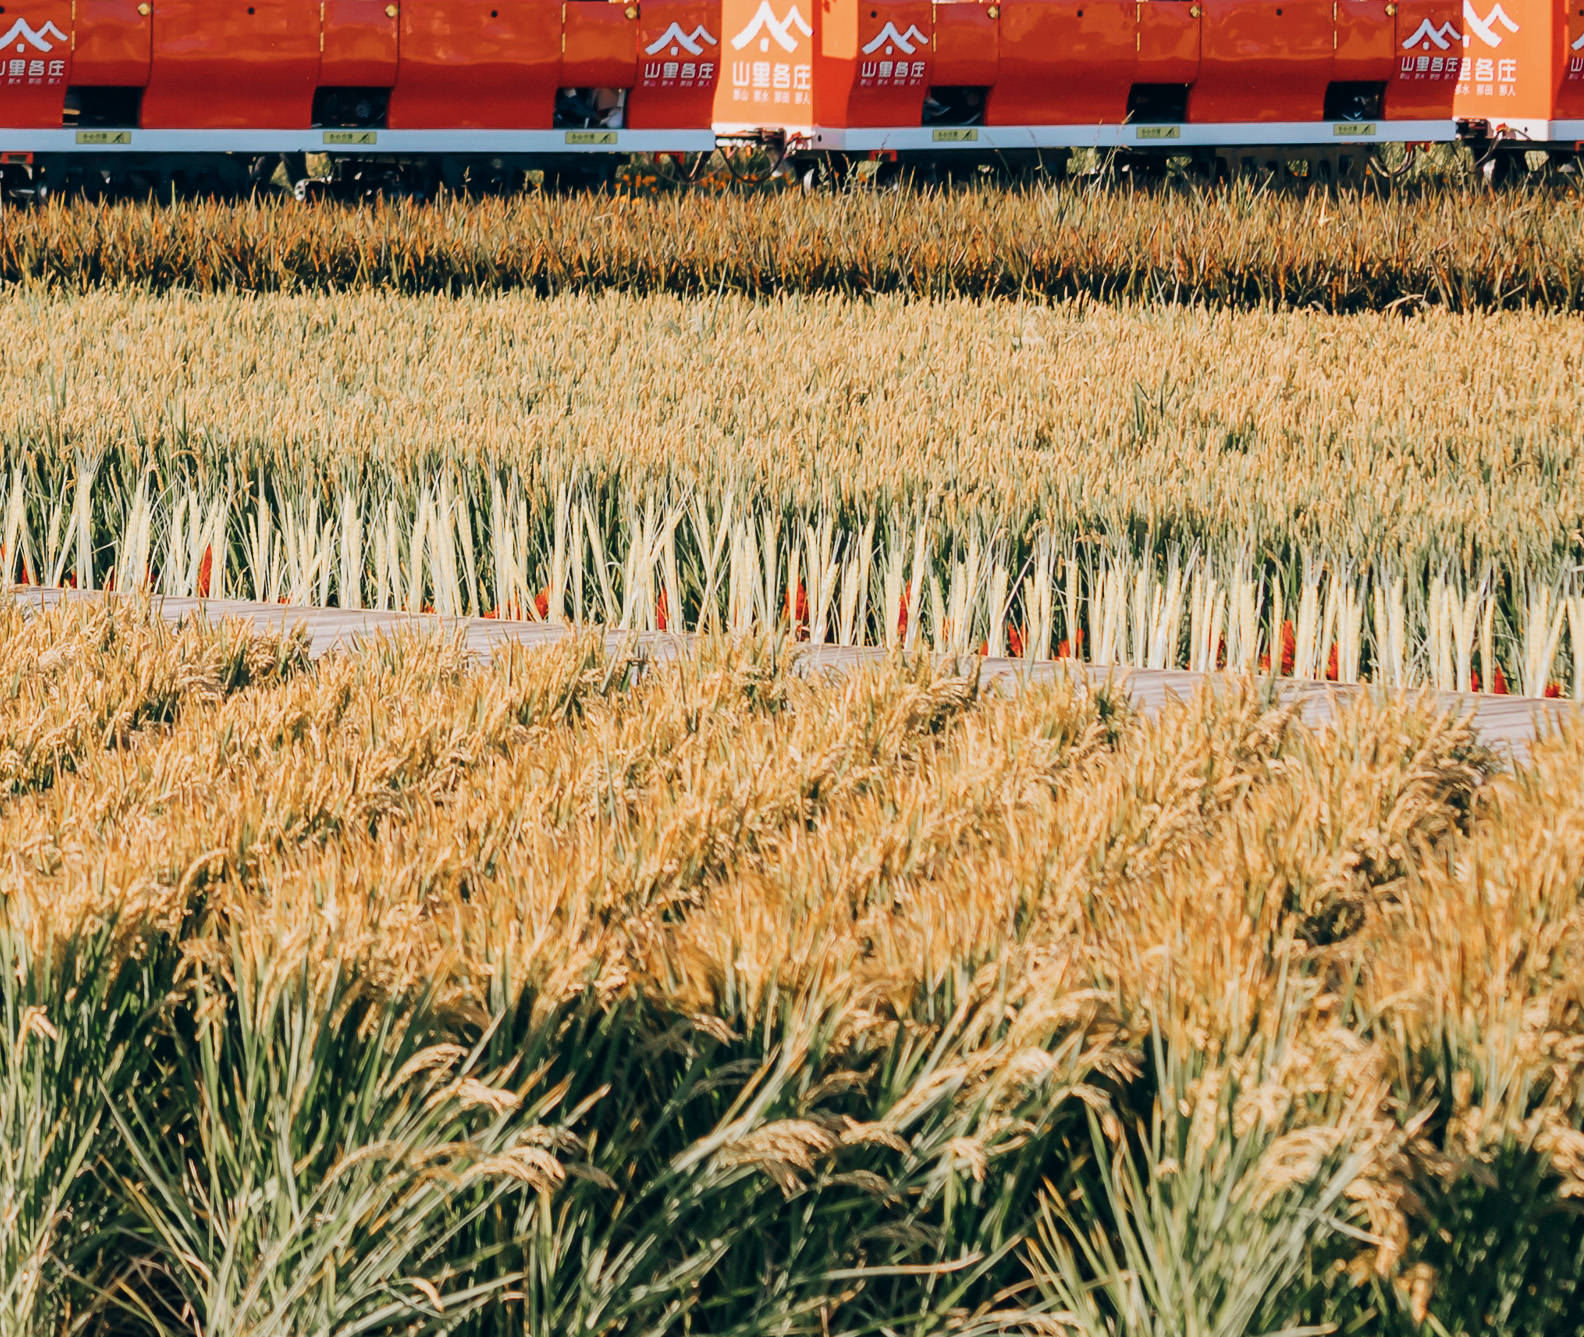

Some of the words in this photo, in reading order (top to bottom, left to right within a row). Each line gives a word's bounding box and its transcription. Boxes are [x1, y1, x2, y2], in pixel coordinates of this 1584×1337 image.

[644, 61, 714, 79] 山里各庄
[862, 61, 926, 77] 山里各庄
[1401, 56, 1458, 72] 山里各庄
[732, 61, 811, 89] 山里各庄
